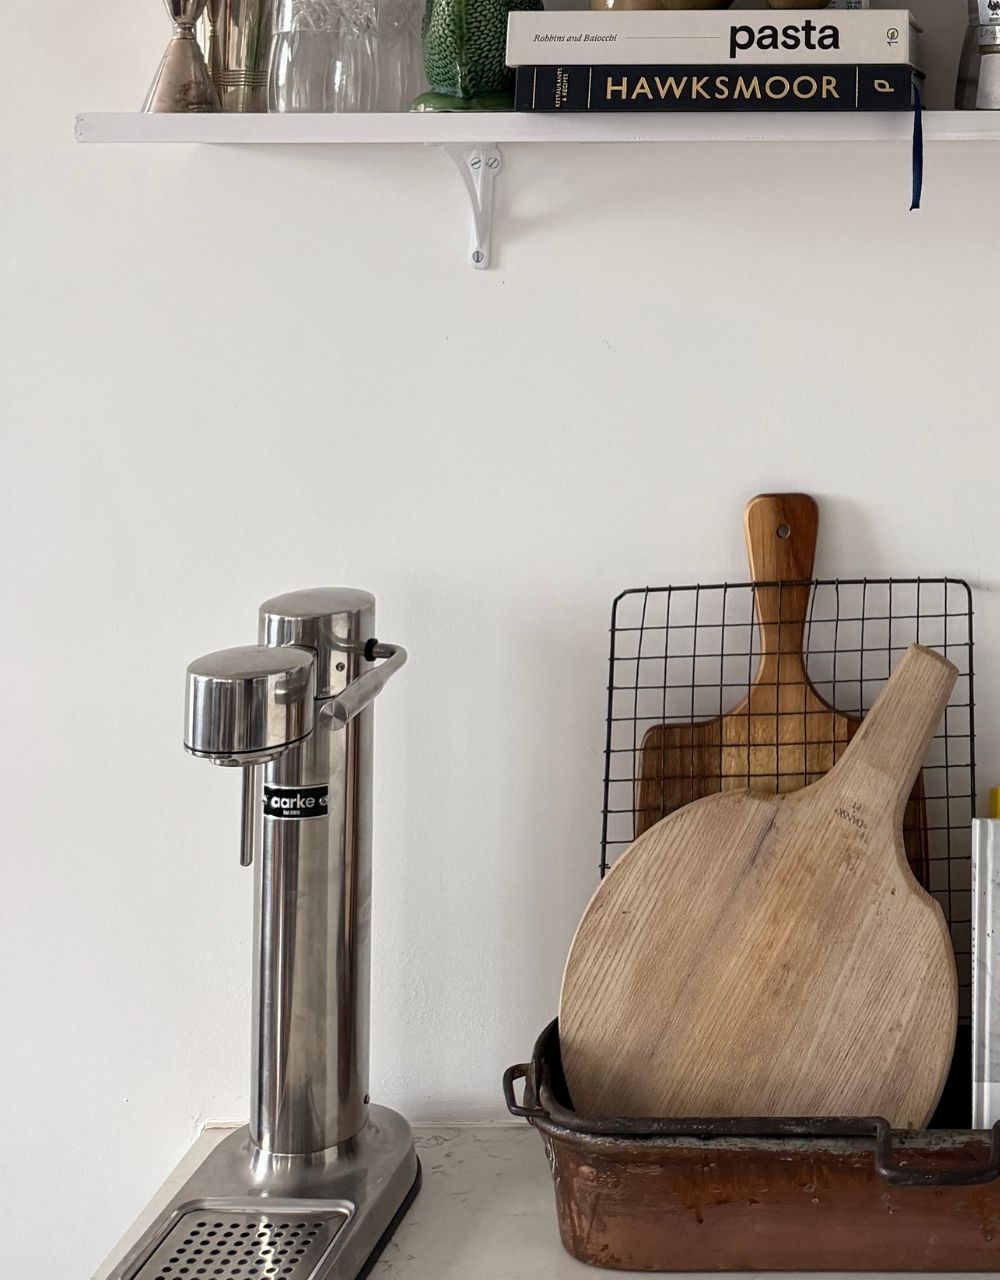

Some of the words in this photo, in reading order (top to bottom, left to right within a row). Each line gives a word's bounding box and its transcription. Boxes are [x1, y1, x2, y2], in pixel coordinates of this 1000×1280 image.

[533, 33, 565, 43] Robbins
[566, 33, 582, 42] and
[583, 33, 618, 42] Baiocchi
[729, 19, 840, 59] pasta
[605, 75, 840, 100] HAWKSMOOR
[271, 793, 315, 808] aarke
